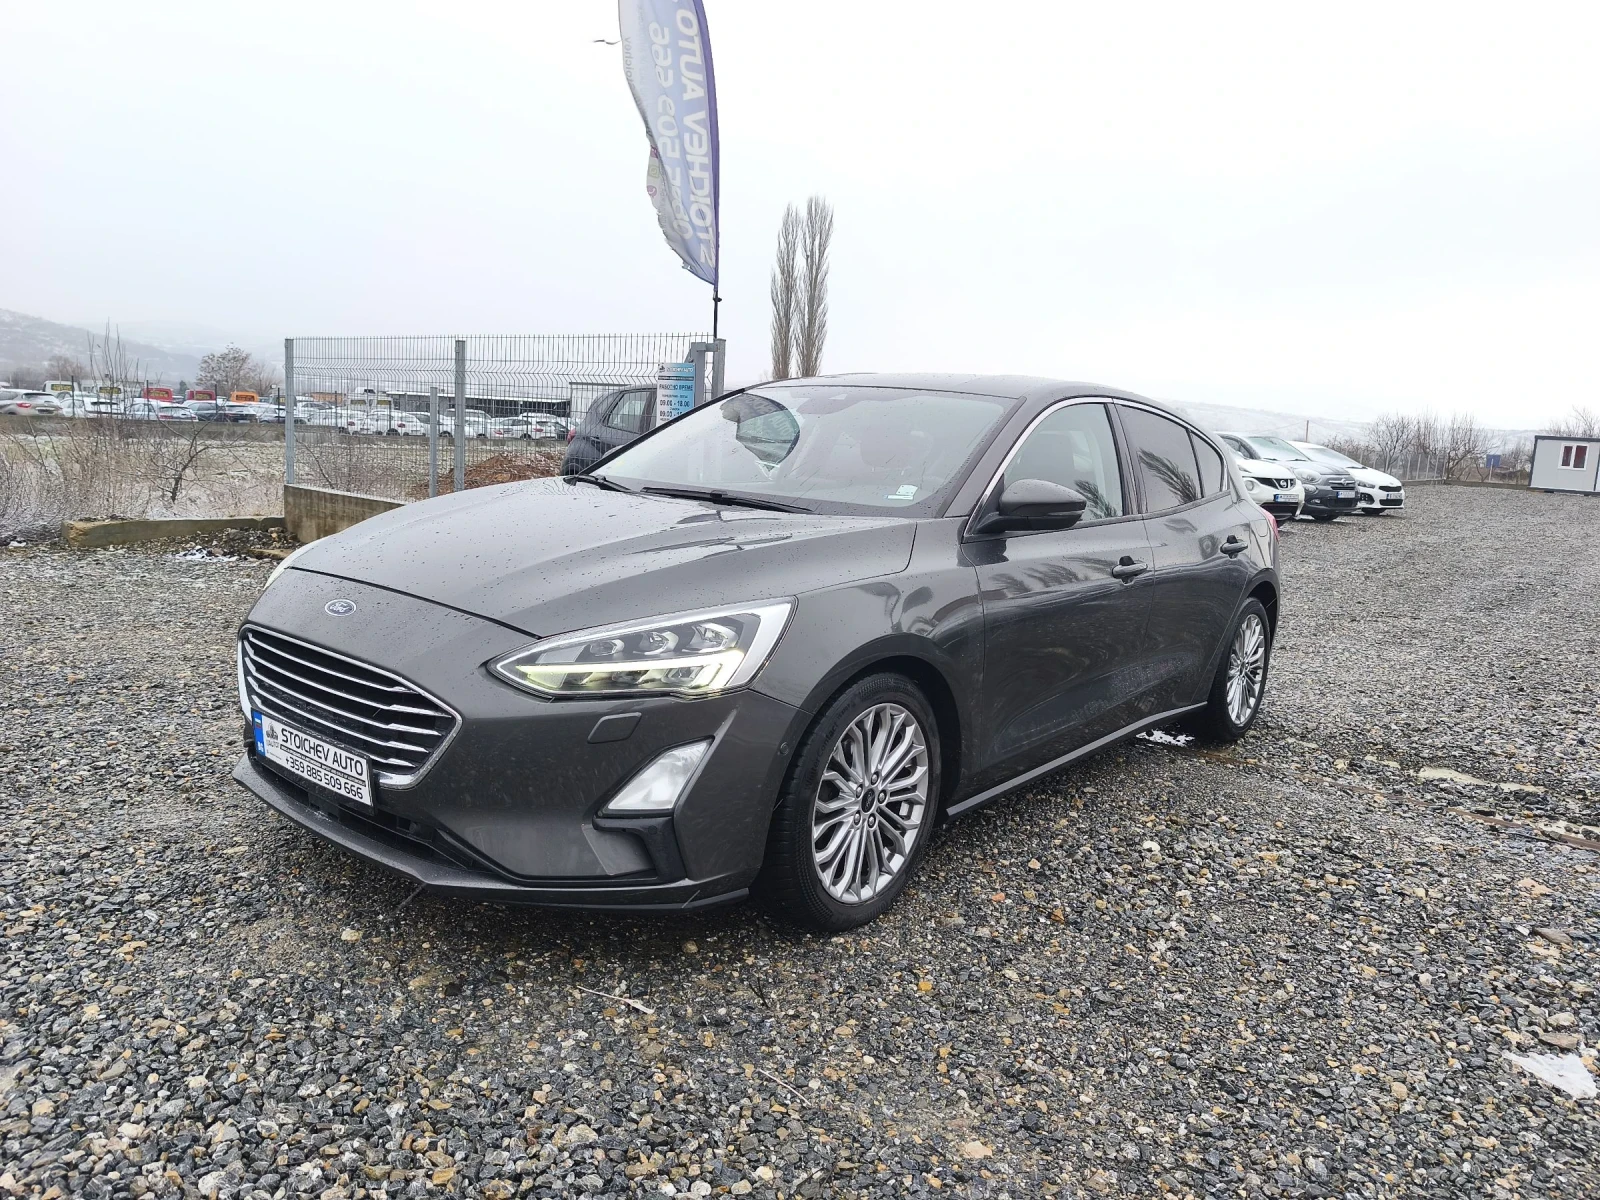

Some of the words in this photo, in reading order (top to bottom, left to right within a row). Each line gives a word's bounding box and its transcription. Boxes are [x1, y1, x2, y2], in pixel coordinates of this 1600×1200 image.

[329, 601, 350, 613] Ford
[281, 727, 330, 763] STOICHEV
[332, 751, 364, 777] AUTO
[285, 755, 305, 773] +359
[306, 765, 322, 782] 885
[324, 774, 341, 791] 509
[343, 781, 364, 800] 666
